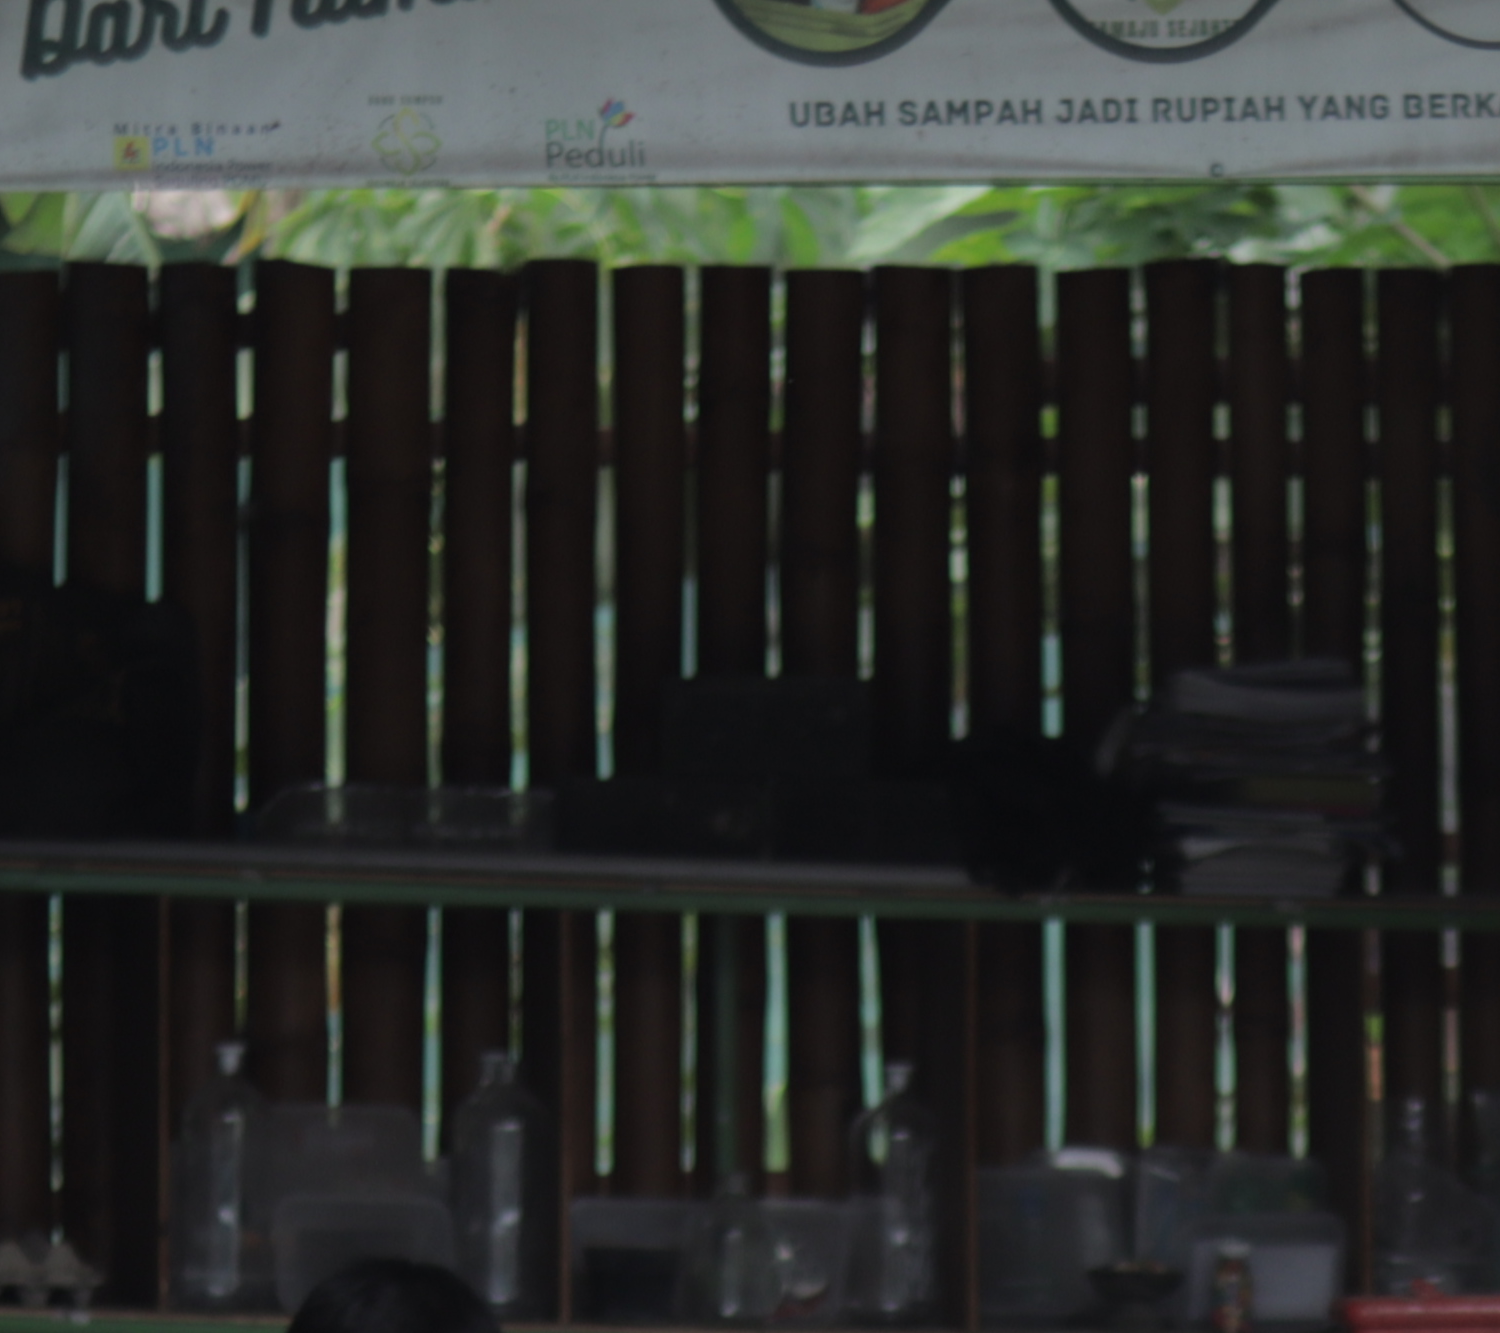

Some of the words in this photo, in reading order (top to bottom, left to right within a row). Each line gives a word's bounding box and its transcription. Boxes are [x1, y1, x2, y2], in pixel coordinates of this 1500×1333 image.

[788, 100, 886, 128] UBAH
[898, 98, 1044, 127] SAMPAH
[1055, 97, 1140, 125] JADI
[1151, 95, 1287, 124] RUPIAH
[1295, 93, 1392, 122] YANG
[543, 118, 595, 141] PLN
[151, 137, 215, 157] PLN
[543, 138, 647, 170] Peduli
